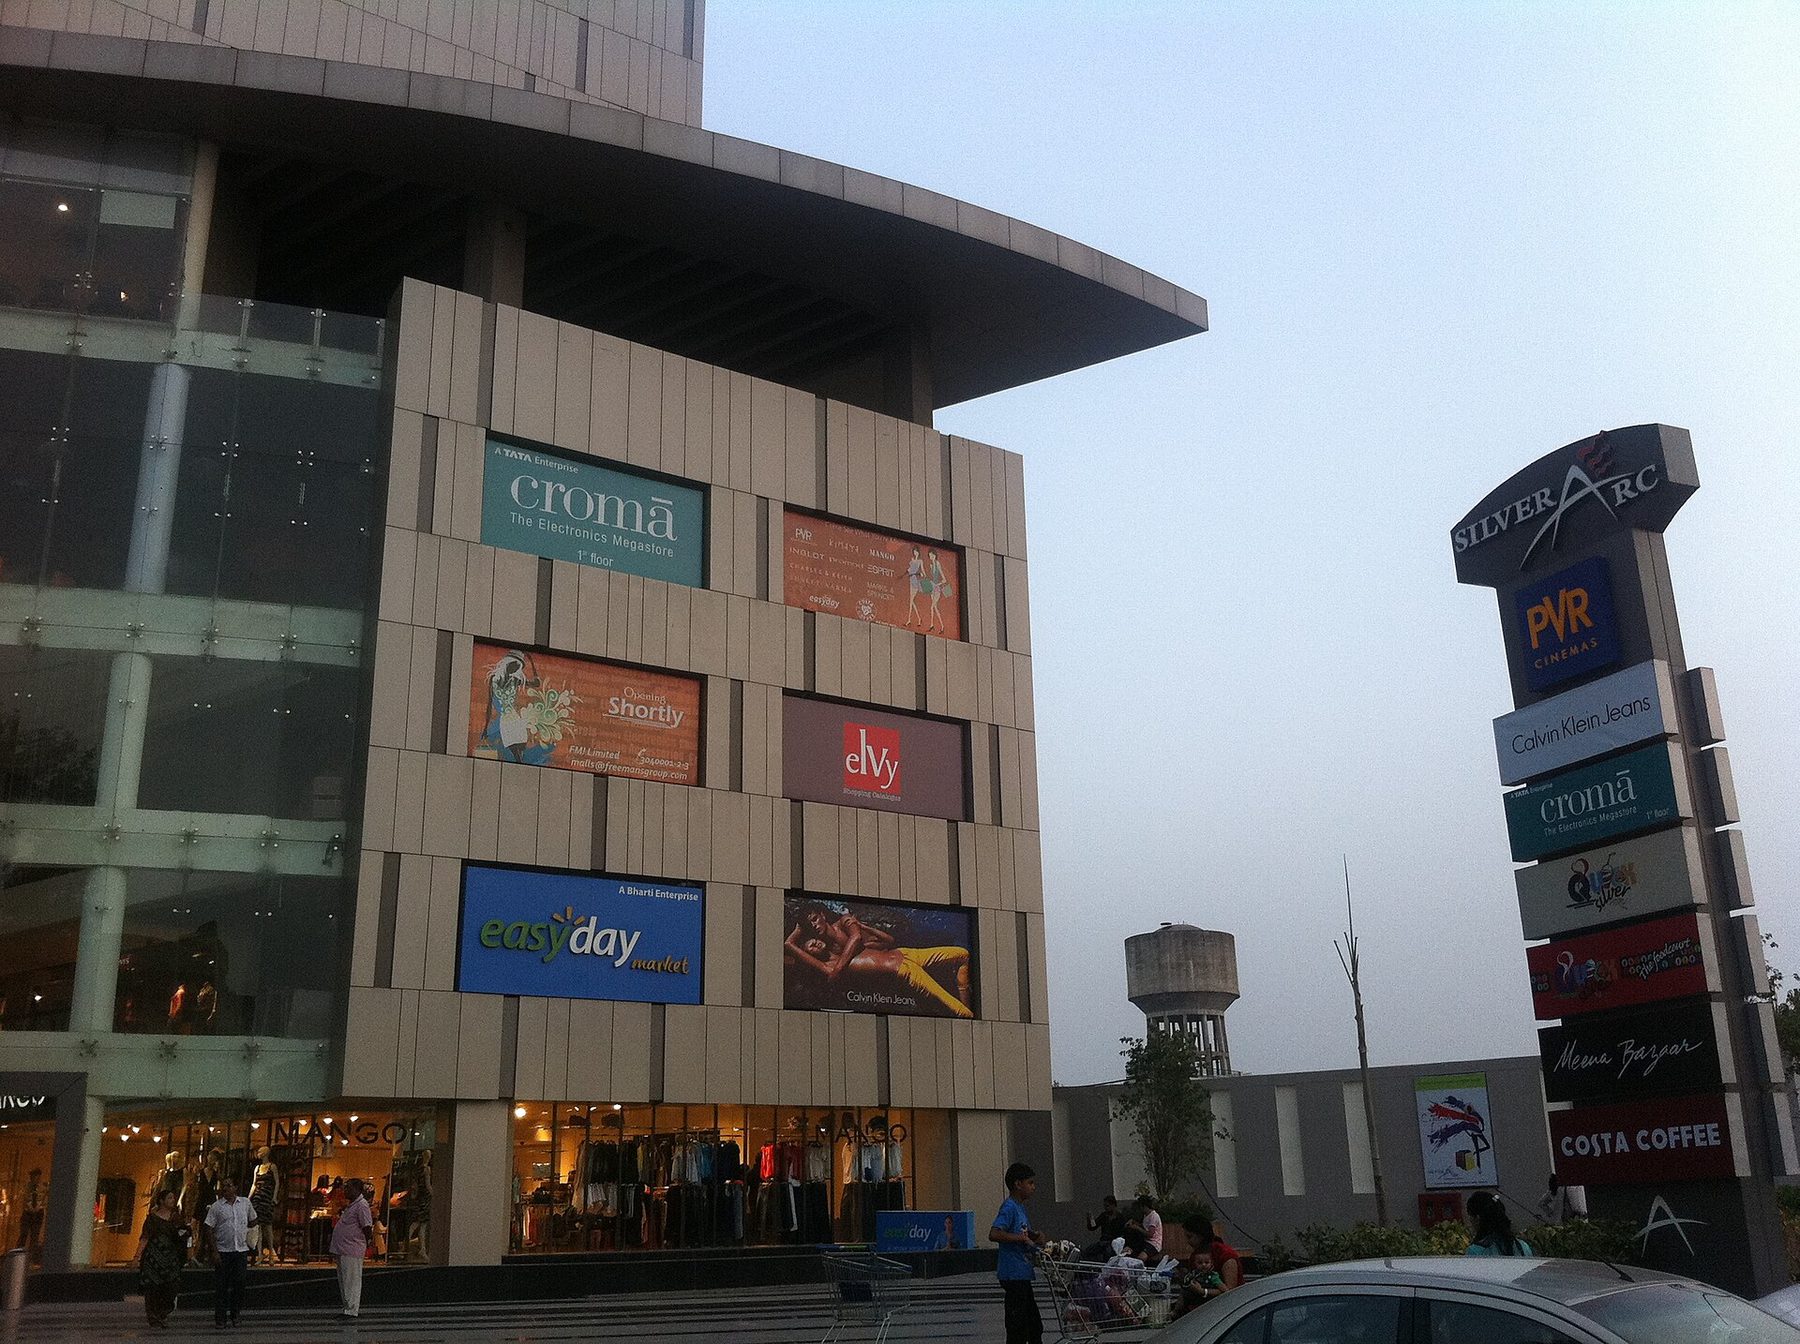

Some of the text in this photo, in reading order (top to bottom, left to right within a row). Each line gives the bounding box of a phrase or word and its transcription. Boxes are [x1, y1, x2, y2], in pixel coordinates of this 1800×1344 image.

[502, 449, 532, 462] TATA
[535, 456, 578, 474] Enterprise
[1454, 464, 1659, 571] SILVER ARC
[511, 512, 674, 558] The Electronics Megastore
[796, 528, 812, 540] PVR
[591, 552, 613, 567] floor
[790, 548, 825, 560] INGLOT
[870, 549, 895, 560] MANGO
[868, 565, 895, 577] ESPRIT
[809, 595, 840, 609] easyday
[1527, 588, 1594, 649] PVR
[1535, 638, 1598, 669] CINEMAS
[623, 686, 668, 706] Opening
[608, 697, 684, 728] Shortly
[1512, 697, 1650, 754] Calvin Klein Jeans
[587, 748, 620, 759] Limited
[571, 759, 688, 780] malls@freemansgroup.com
[1515, 790, 1529, 798] TATA
[1558, 816, 1597, 833] Electronics
[1600, 806, 1637, 822] Megastore
[1654, 807, 1669, 818] floor
[619, 886, 698, 902] A Bharti Enterprise
[480, 916, 641, 968] easyday
[631, 956, 690, 975] market
[847, 991, 916, 1006] Calvin Klein Jeans
[1553, 1038, 1703, 1080] Meena Bazaar
[274, 1122, 407, 1144] MANGO
[1561, 1123, 1721, 1157] COSTA COFFEE
